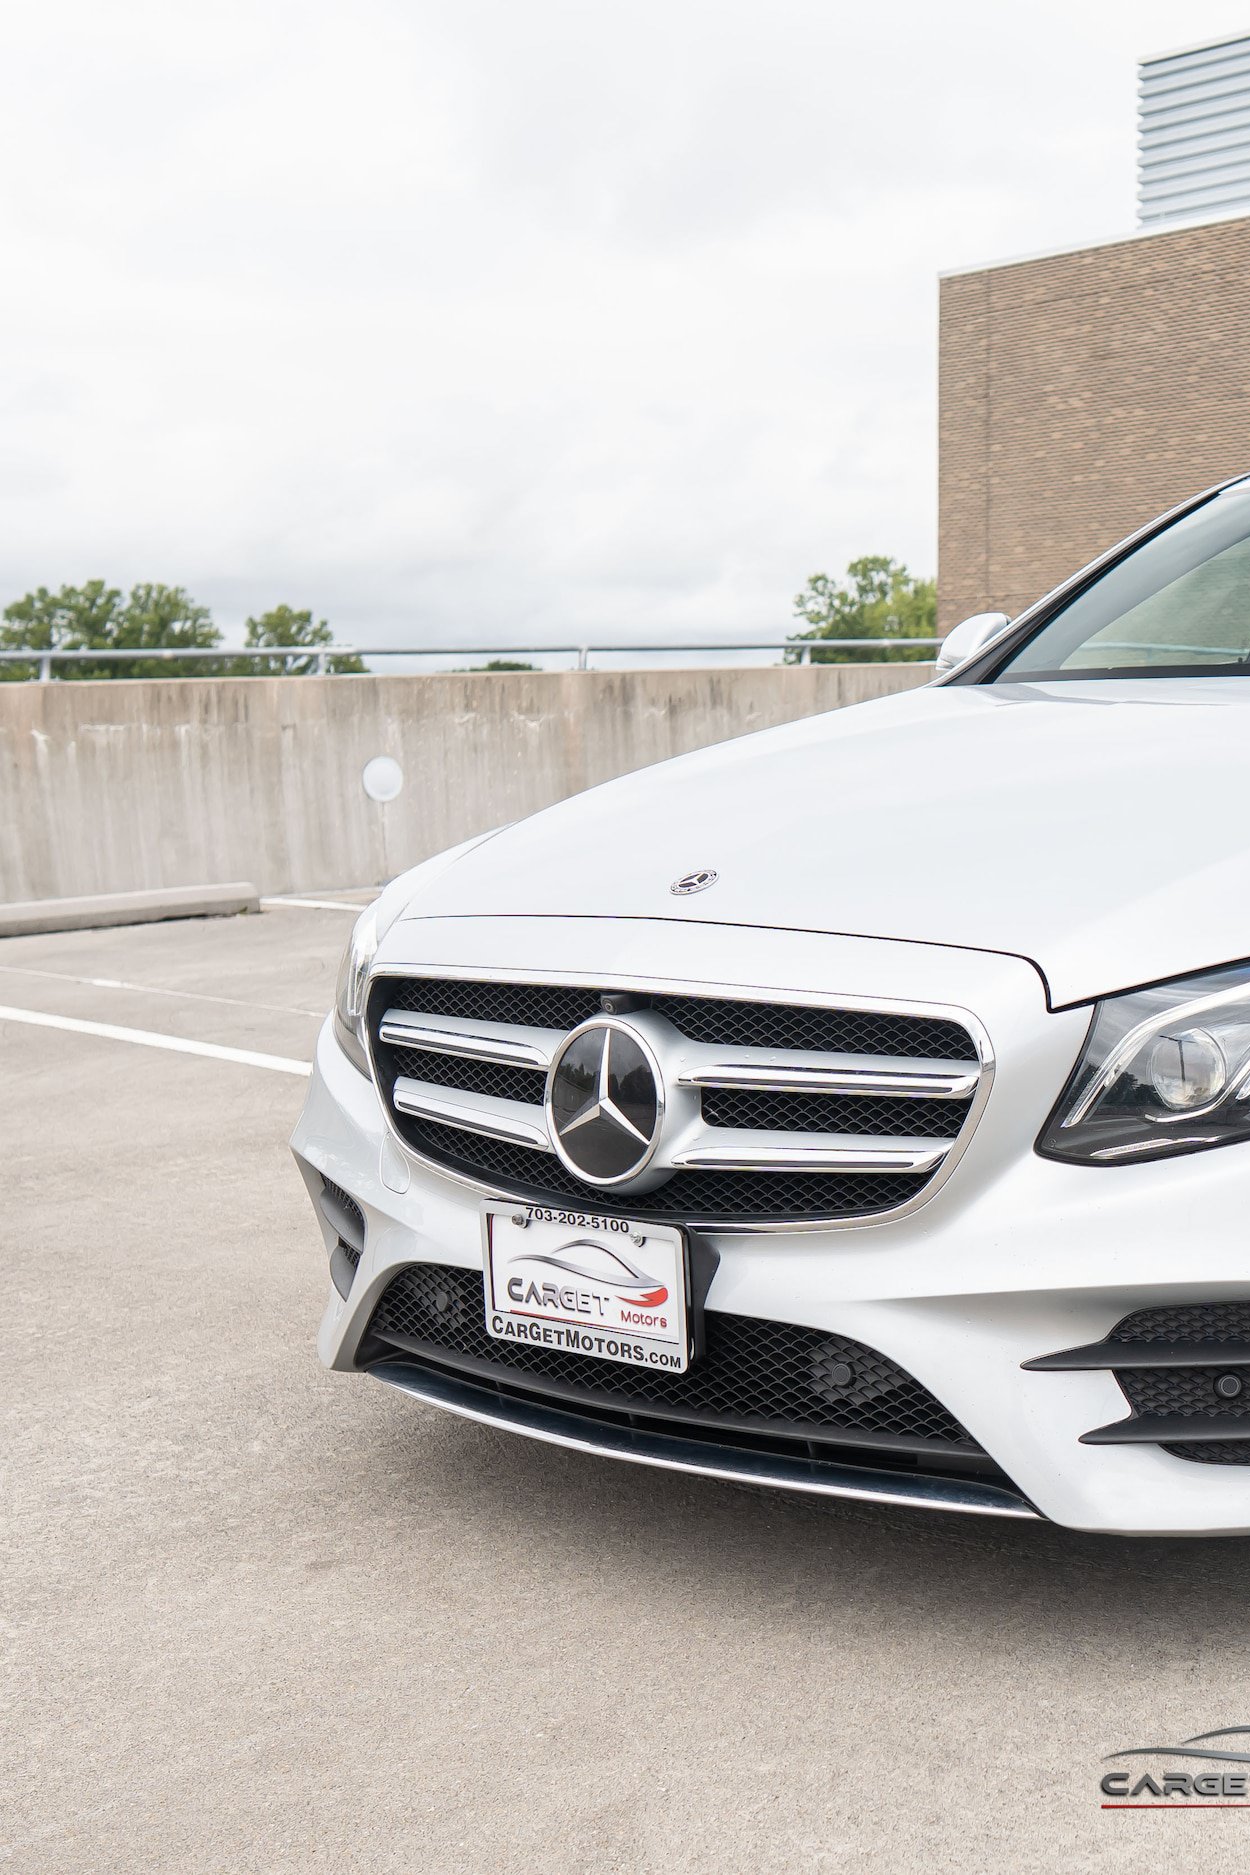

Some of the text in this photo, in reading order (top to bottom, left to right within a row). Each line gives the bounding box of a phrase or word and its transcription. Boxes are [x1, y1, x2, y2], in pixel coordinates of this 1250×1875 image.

[525, 1207, 629, 1233] 703-202-5100
[507, 1277, 610, 1316] CARGET
[620, 1310, 667, 1328] Motors
